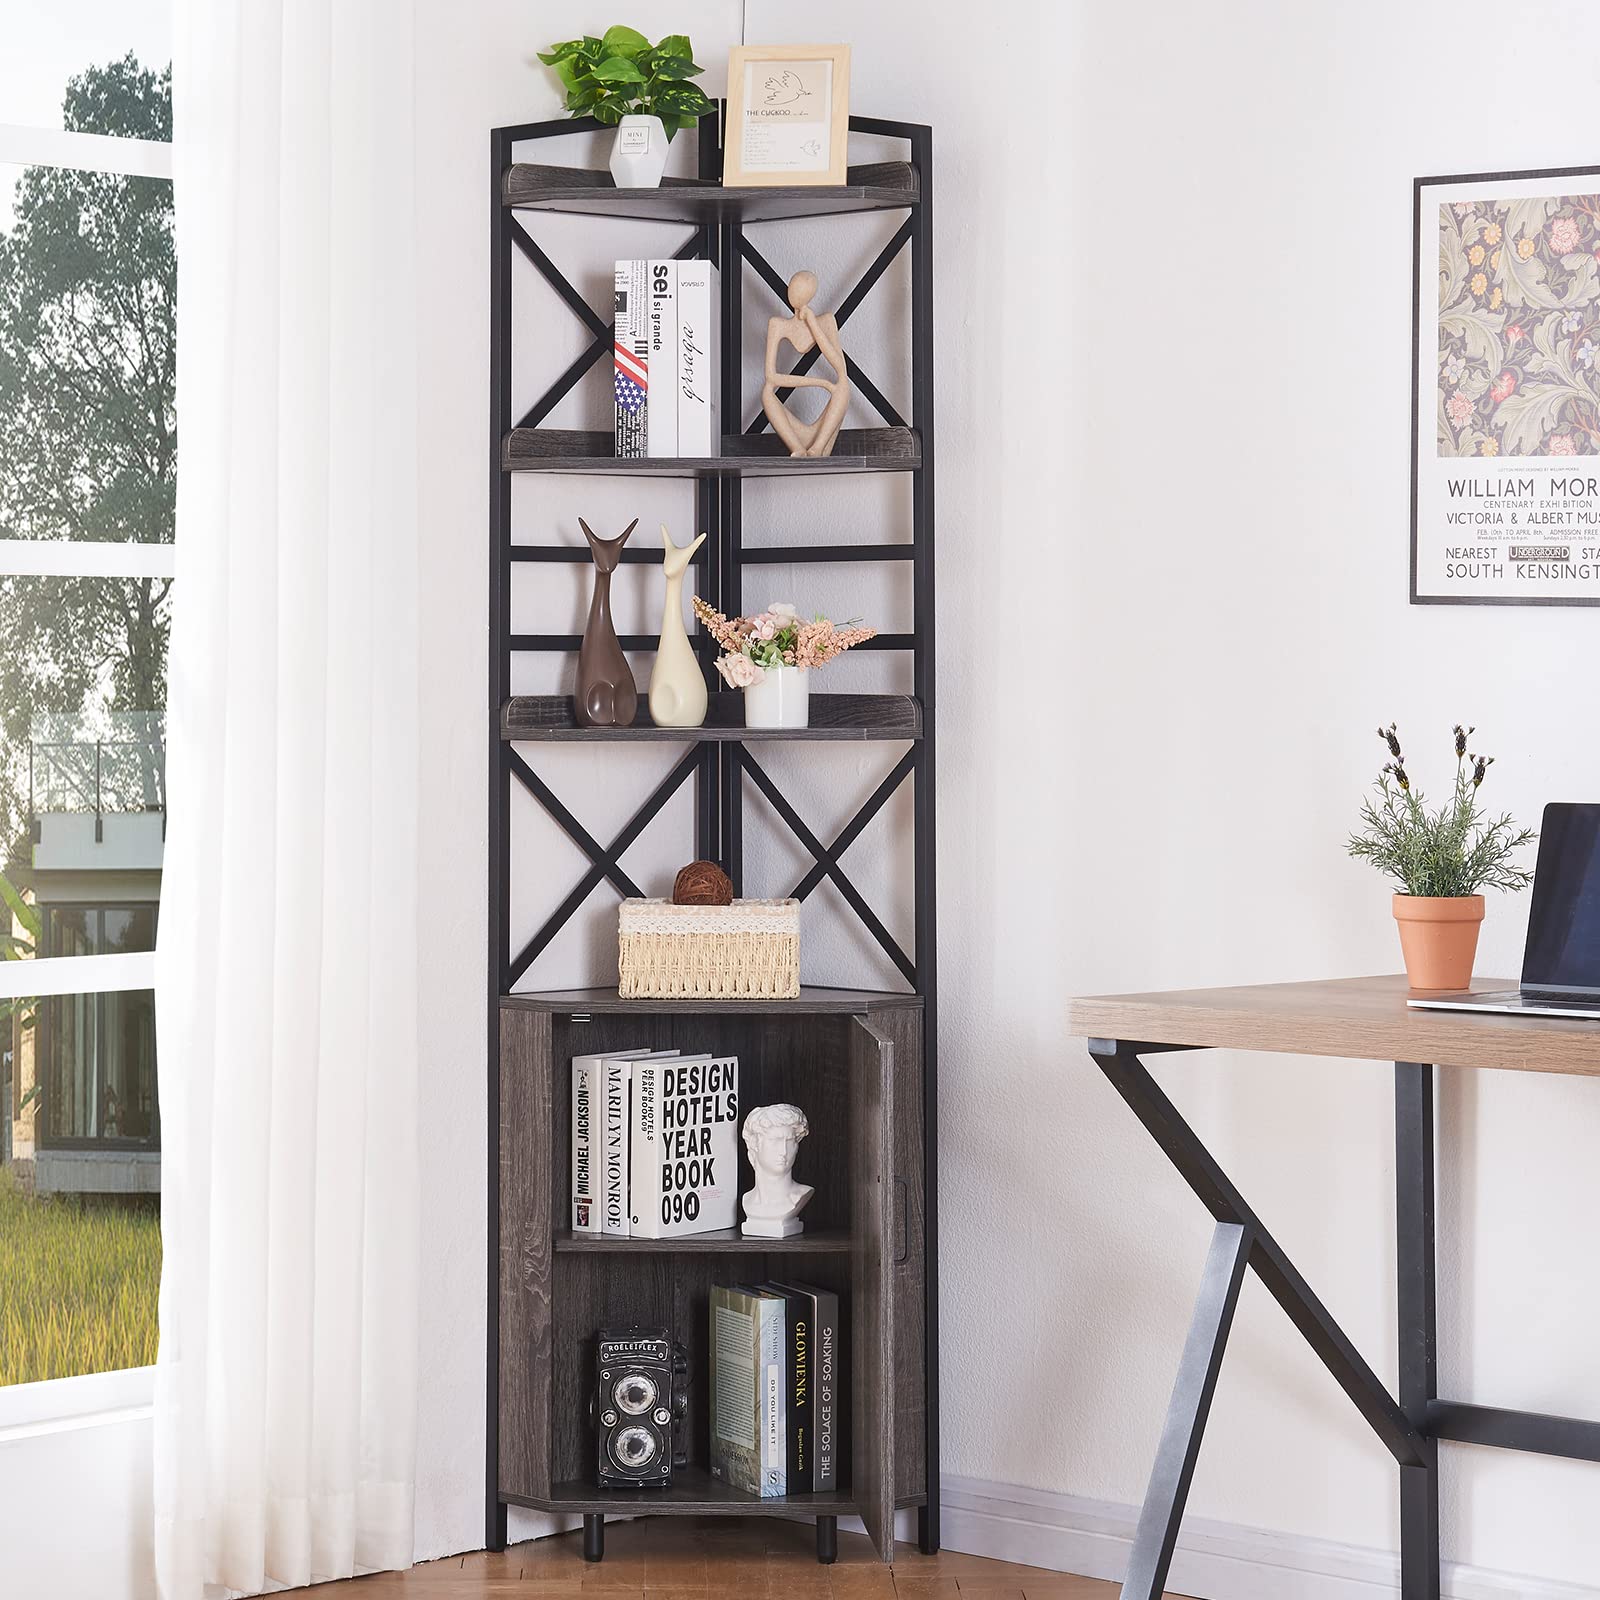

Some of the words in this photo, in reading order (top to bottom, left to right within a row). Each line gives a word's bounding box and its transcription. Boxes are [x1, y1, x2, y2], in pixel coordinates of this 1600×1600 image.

[654, 265, 672, 299] sei
[651, 314, 663, 351] grande
[1448, 479, 1534, 498] WILLIAM
[1550, 478, 1600, 497] MOR
[1483, 500, 1534, 509] CENTENARY
[1540, 500, 1592, 508] EXHIBITION
[1446, 513, 1504, 525] VICTORIA
[1511, 513, 1518, 524] &
[1527, 512, 1573, 524] ALBERT
[1577, 512, 1600, 524] MU
[1446, 548, 1497, 559] NEAREST
[1510, 546, 1570, 558] UNDERGROUND
[1446, 564, 1503, 579] SOUTH
[1516, 564, 1600, 579] KENSINGT
[663, 1063, 735, 1097] DESIGN
[578, 1090, 590, 1142] JACKSON
[608, 1067, 622, 1147] MARILYN
[646, 1105, 654, 1142] HOTELS
[663, 1093, 738, 1128] HOTELS
[662, 1128, 712, 1160] YEAR
[578, 1146, 589, 1194] MICHAEL
[662, 1158, 715, 1192] BOOK
[608, 1152, 621, 1228] MONROE
[822, 1327, 832, 1381] SOAKING
[771, 1380, 776, 1391] DO
[822, 1386, 831, 1400] OF
[771, 1436, 776, 1445] IT
[822, 1406, 831, 1451] SOLACE
[822, 1458, 831, 1479] THE
